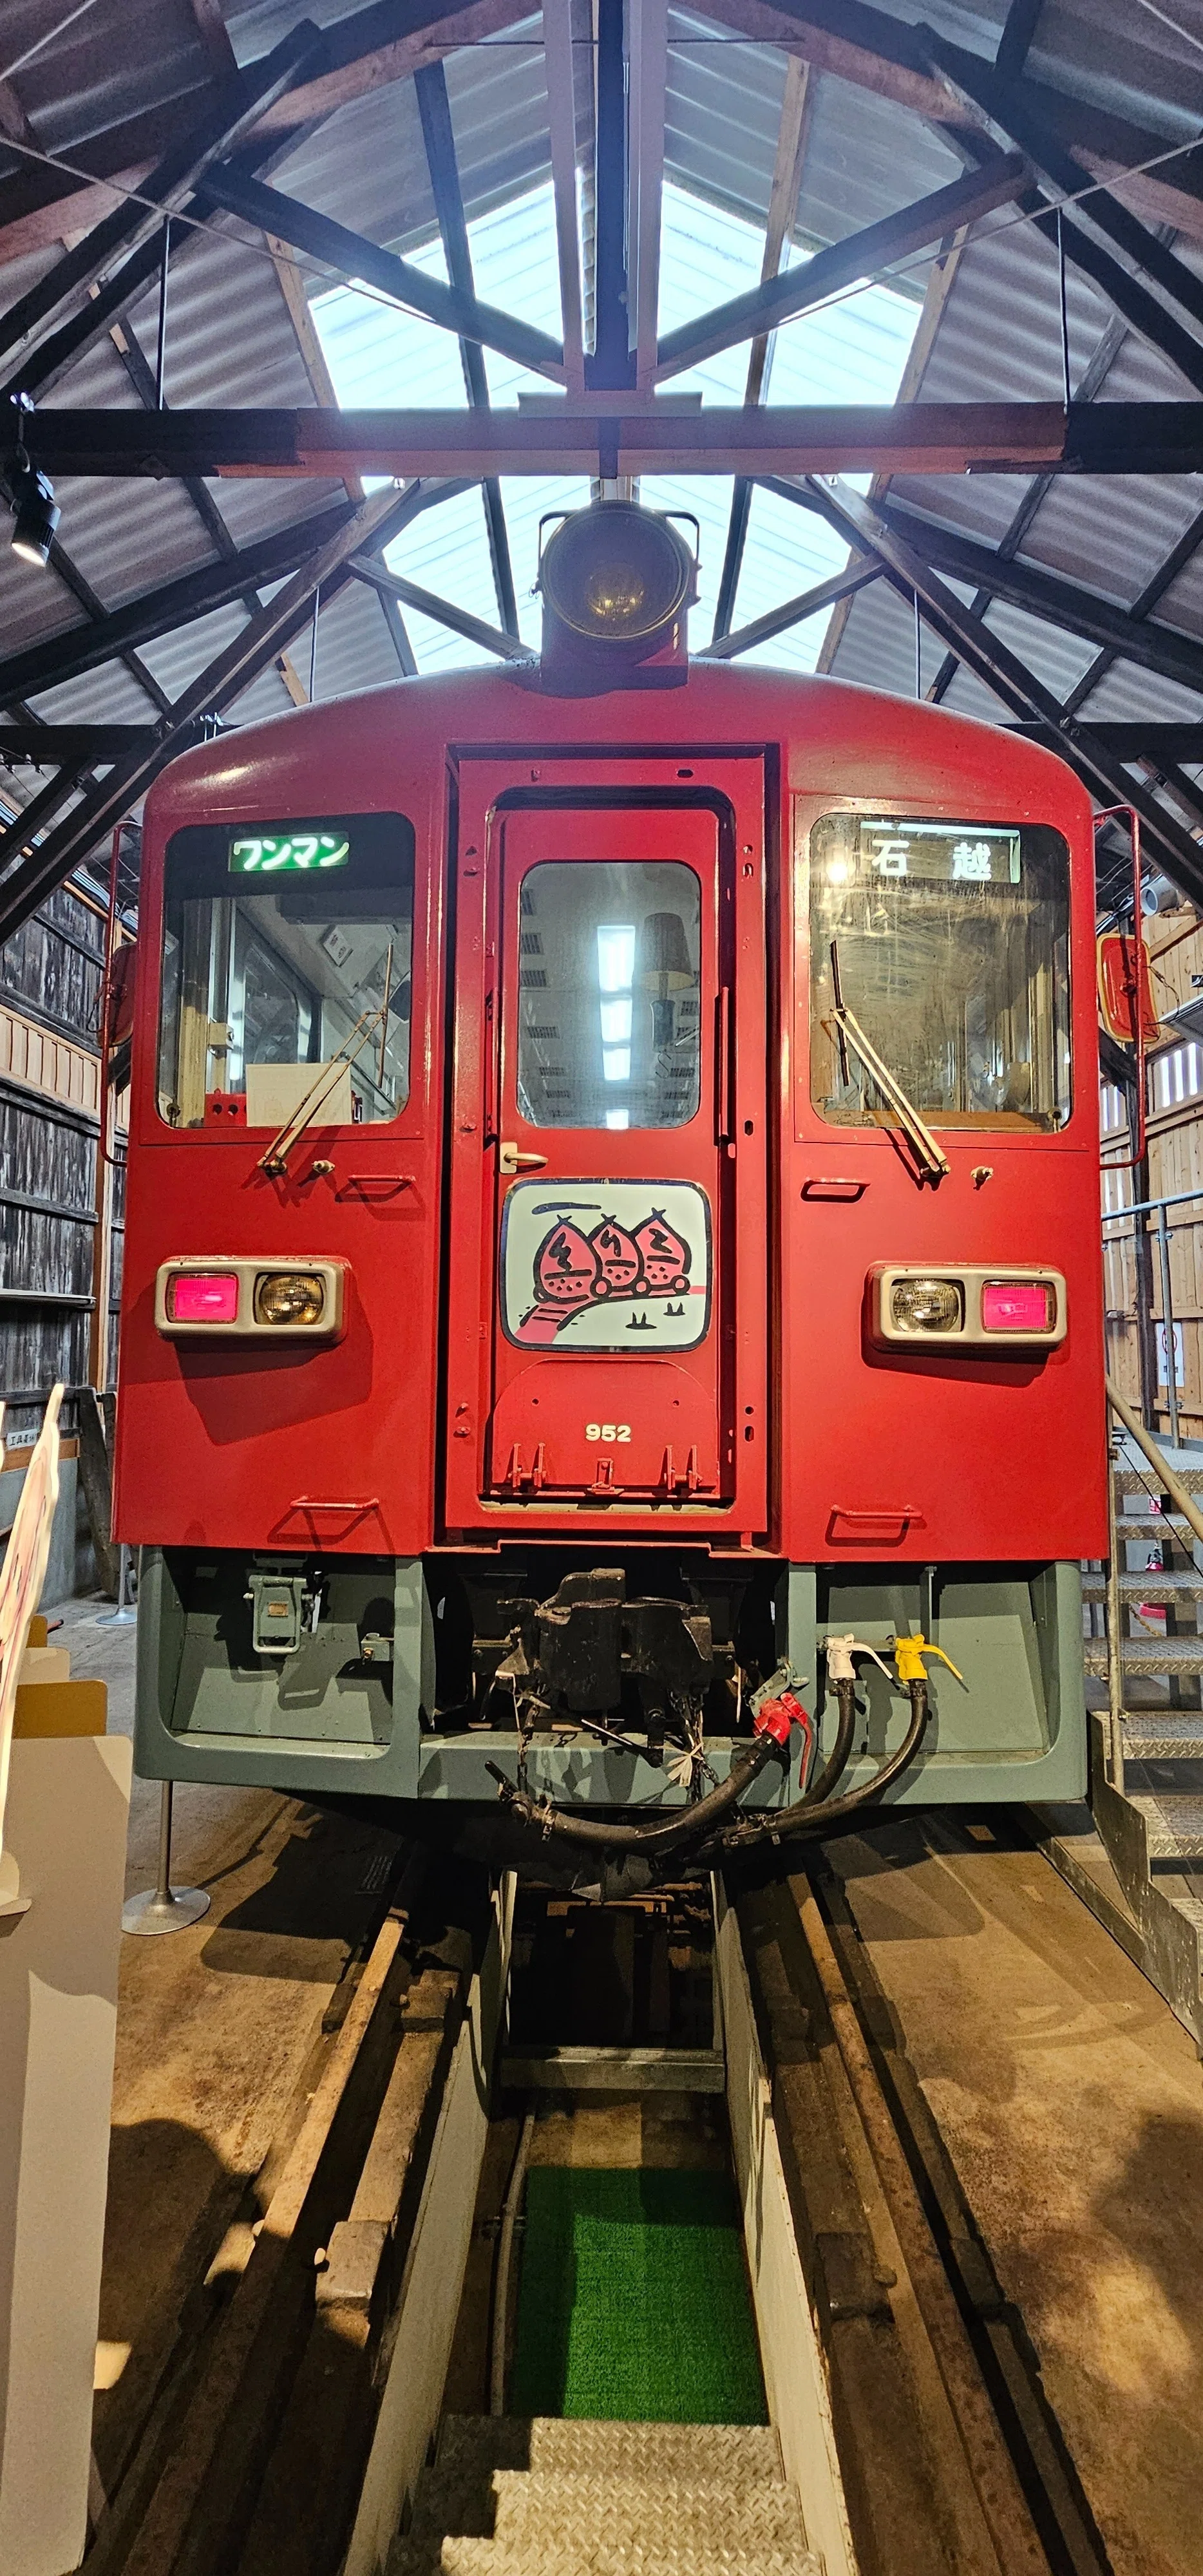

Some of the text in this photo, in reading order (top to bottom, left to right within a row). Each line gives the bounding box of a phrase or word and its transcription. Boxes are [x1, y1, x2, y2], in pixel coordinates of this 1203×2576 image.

[233, 836, 350, 870] ワンマン
[871, 839, 992, 881] 石越
[585, 1423, 631, 1443] 952
